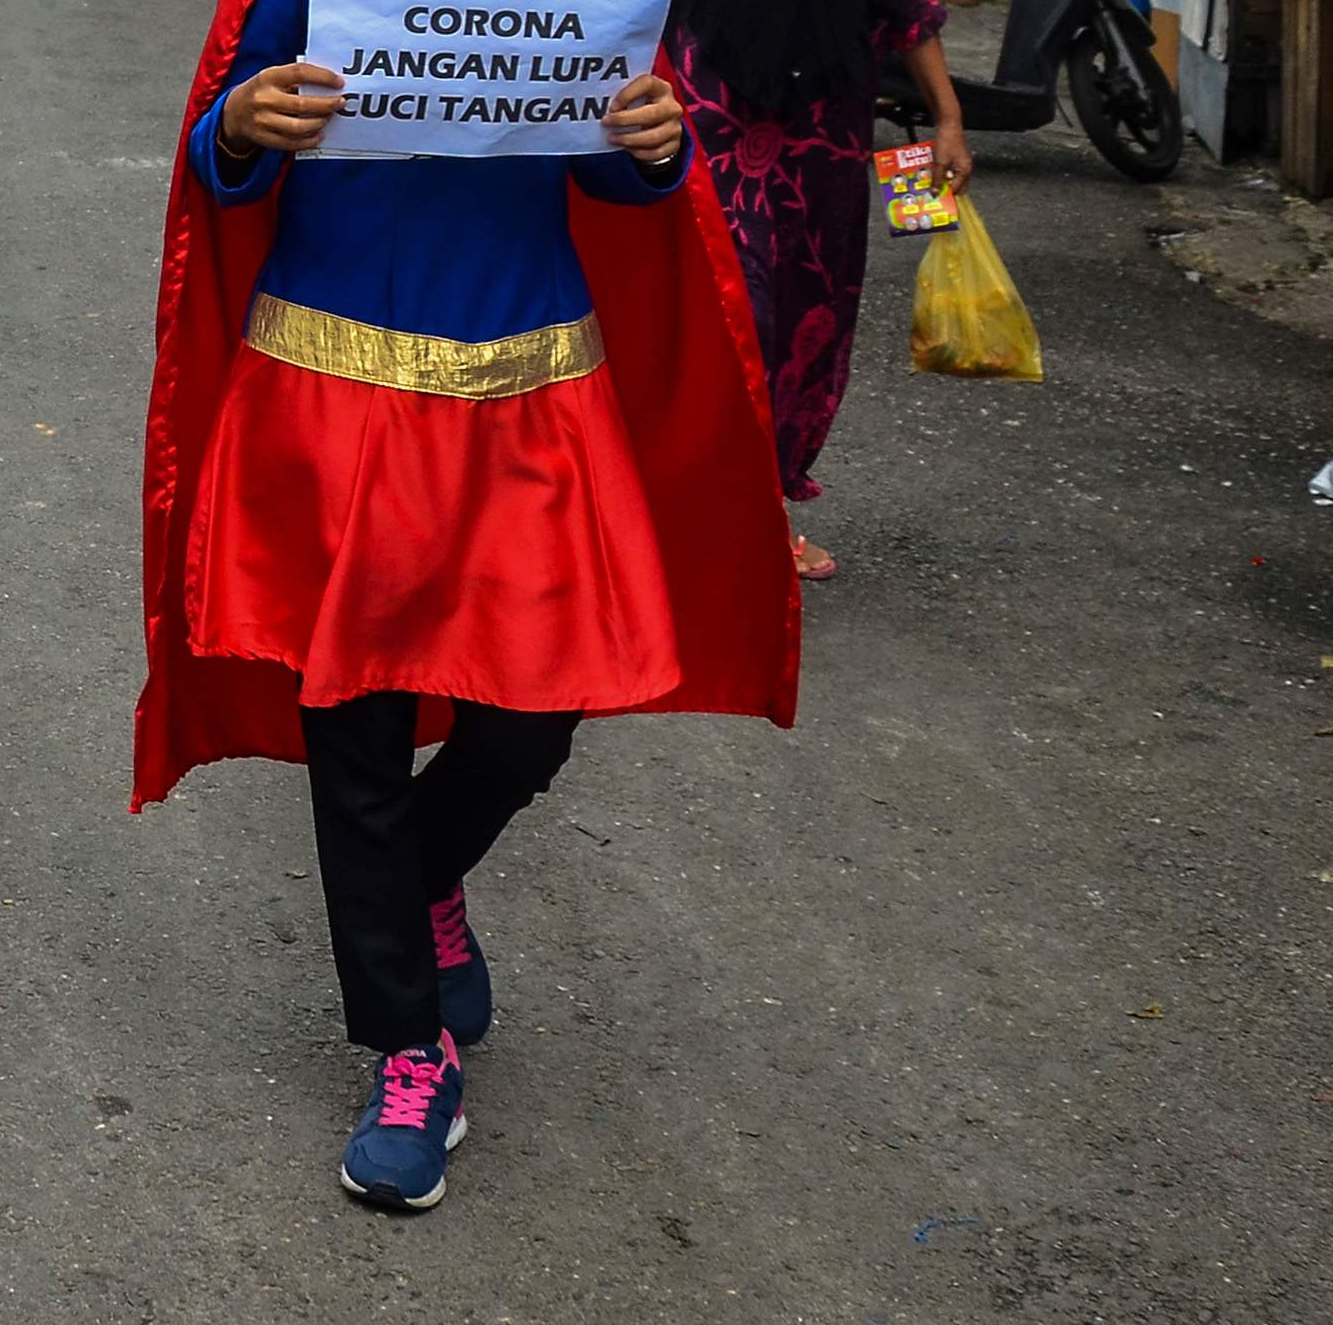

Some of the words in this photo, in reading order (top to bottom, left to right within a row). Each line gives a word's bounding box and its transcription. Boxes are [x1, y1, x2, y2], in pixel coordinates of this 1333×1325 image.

[404, 6, 585, 40] CORONA
[342, 48, 520, 81] JANGAN
[528, 55, 630, 83] LUPA
[335, 92, 429, 121] CUCI
[438, 96, 612, 124] TANGAN
